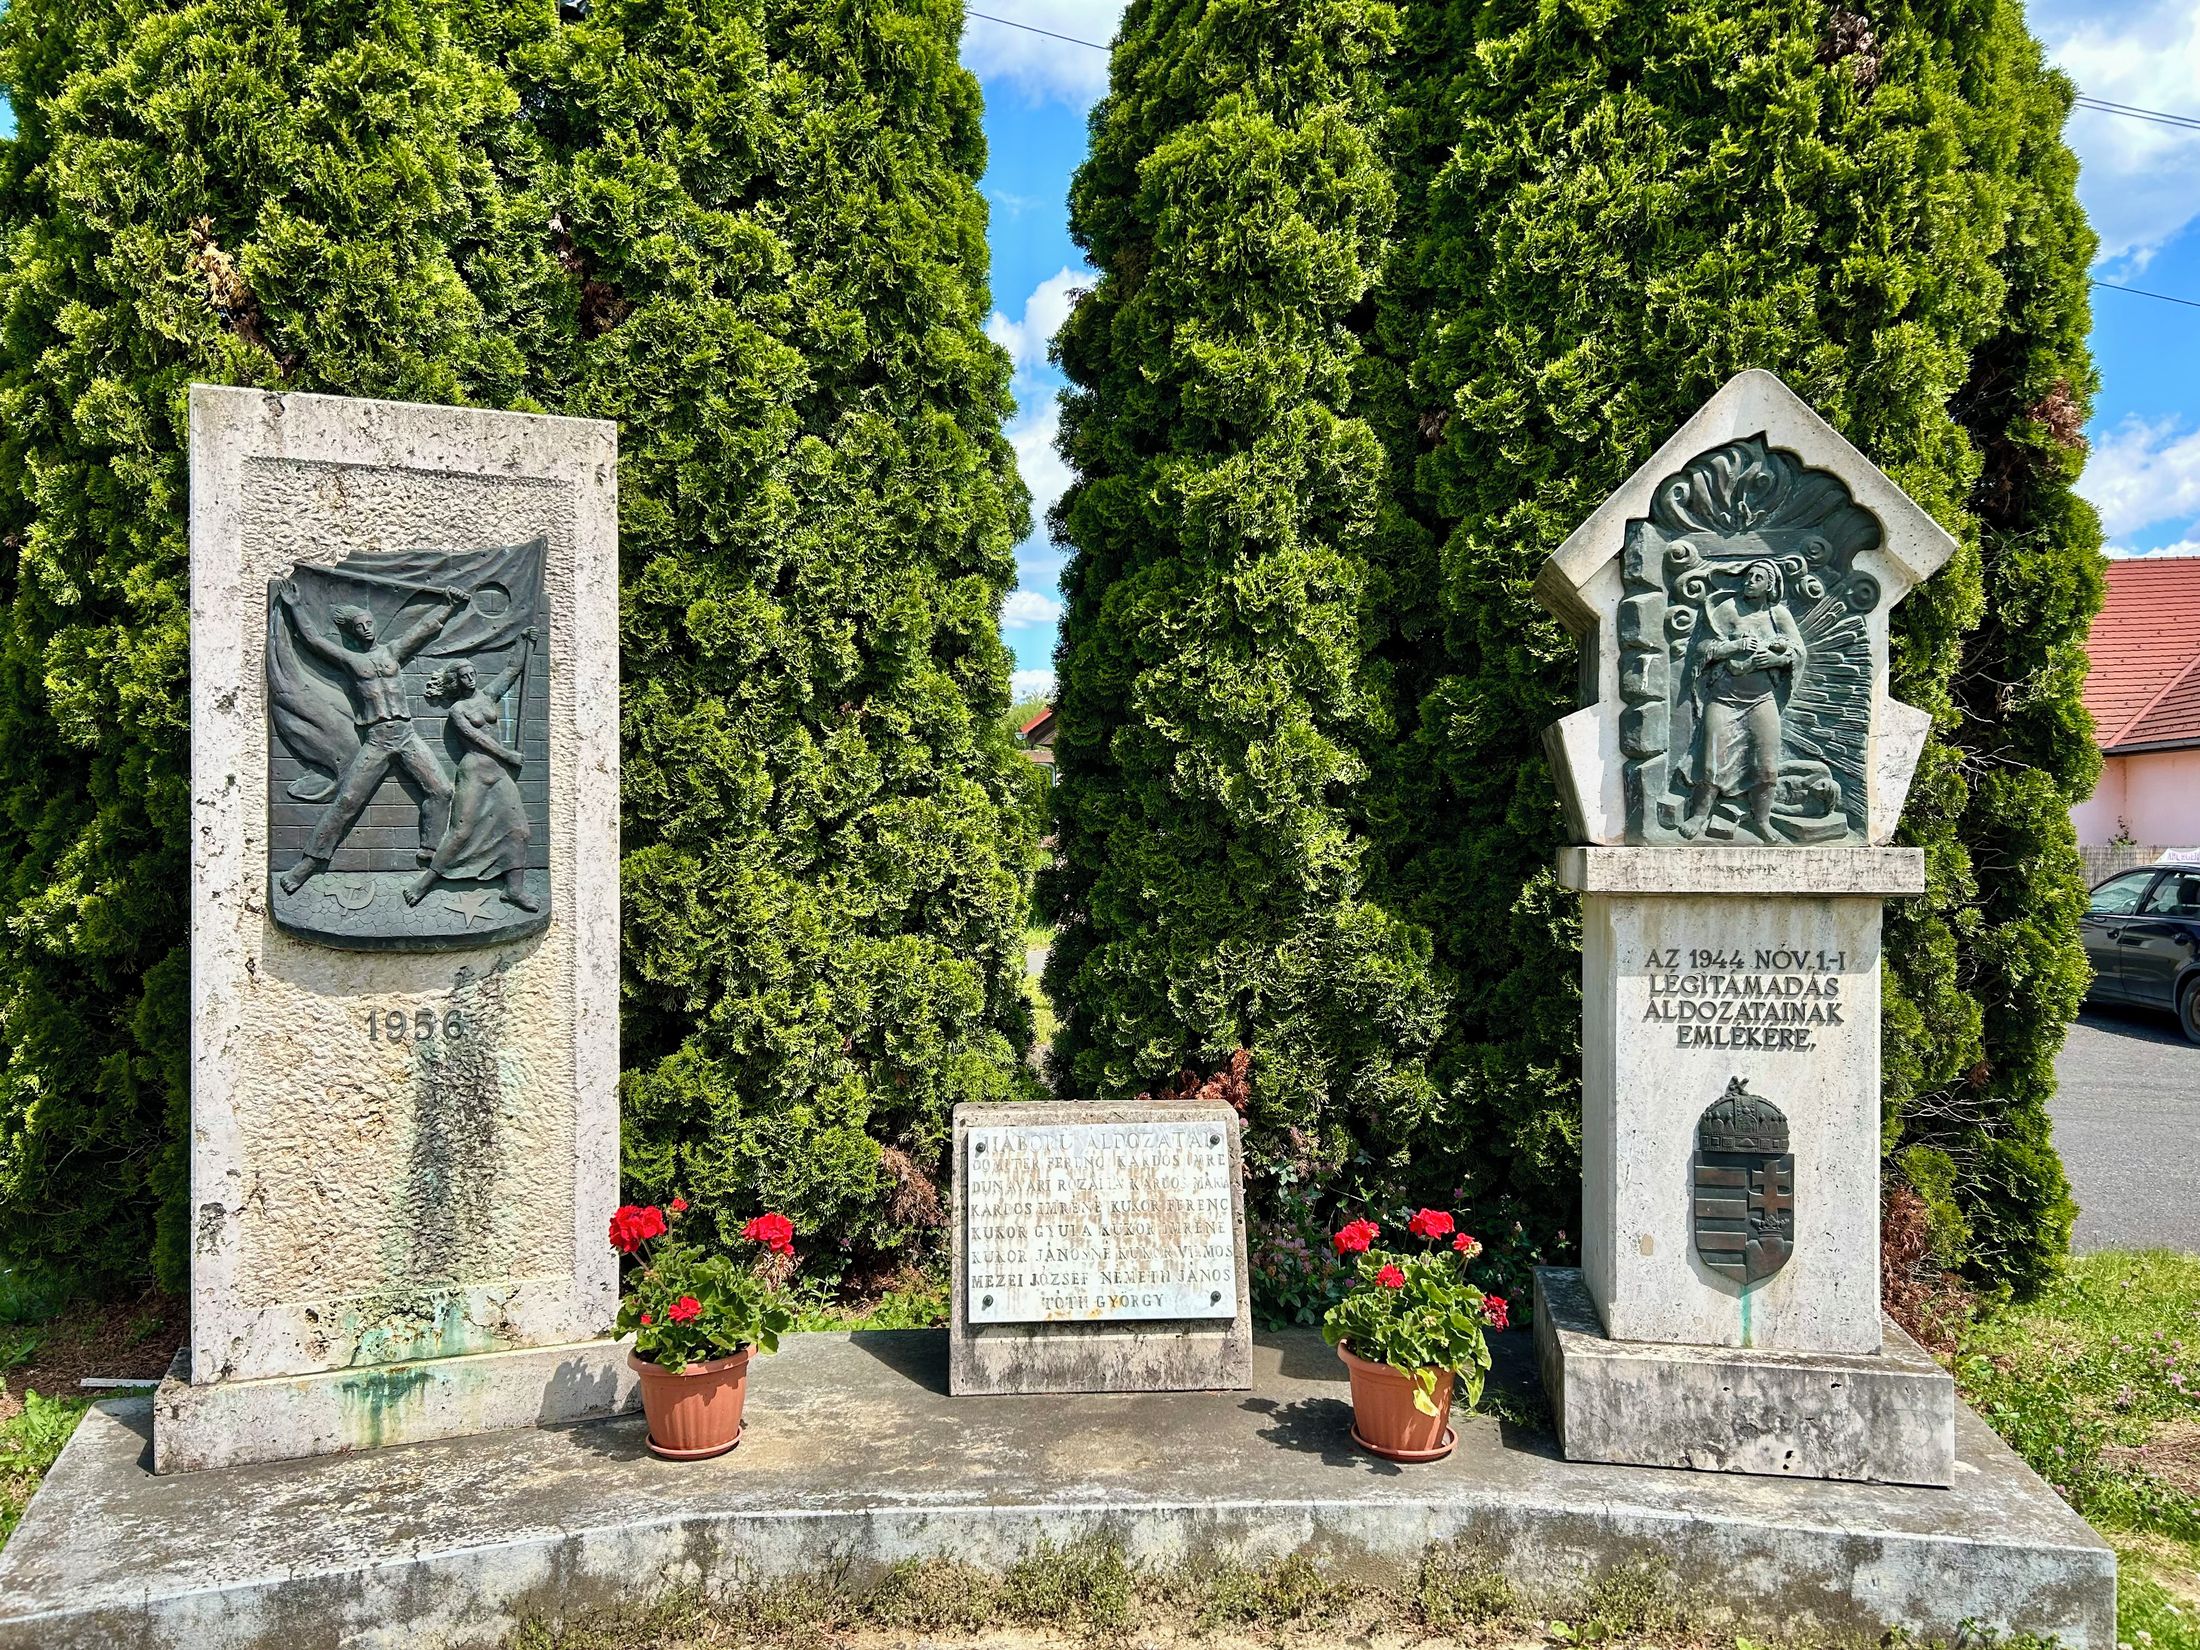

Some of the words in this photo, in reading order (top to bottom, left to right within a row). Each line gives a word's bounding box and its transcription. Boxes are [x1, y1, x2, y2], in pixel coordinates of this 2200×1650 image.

[1645, 948, 1680, 968] AZ
[1689, 949, 1745, 969] 1944
[364, 1007, 464, 1042] 1956
[971, 1202, 1032, 1217] KARDOS
[1111, 1199, 1160, 1213] KUKOR
[1168, 1197, 1229, 1213] FERENC
[971, 1226, 1027, 1240] KUKOR
[1101, 1222, 1155, 1237] KUKOR
[972, 1249, 1027, 1264] KUKOR
[972, 1274, 1023, 1288] MEZEI
[1178, 1261, 1231, 1282] JÁNOS
[1096, 1291, 1163, 1308] GYÖRGY
